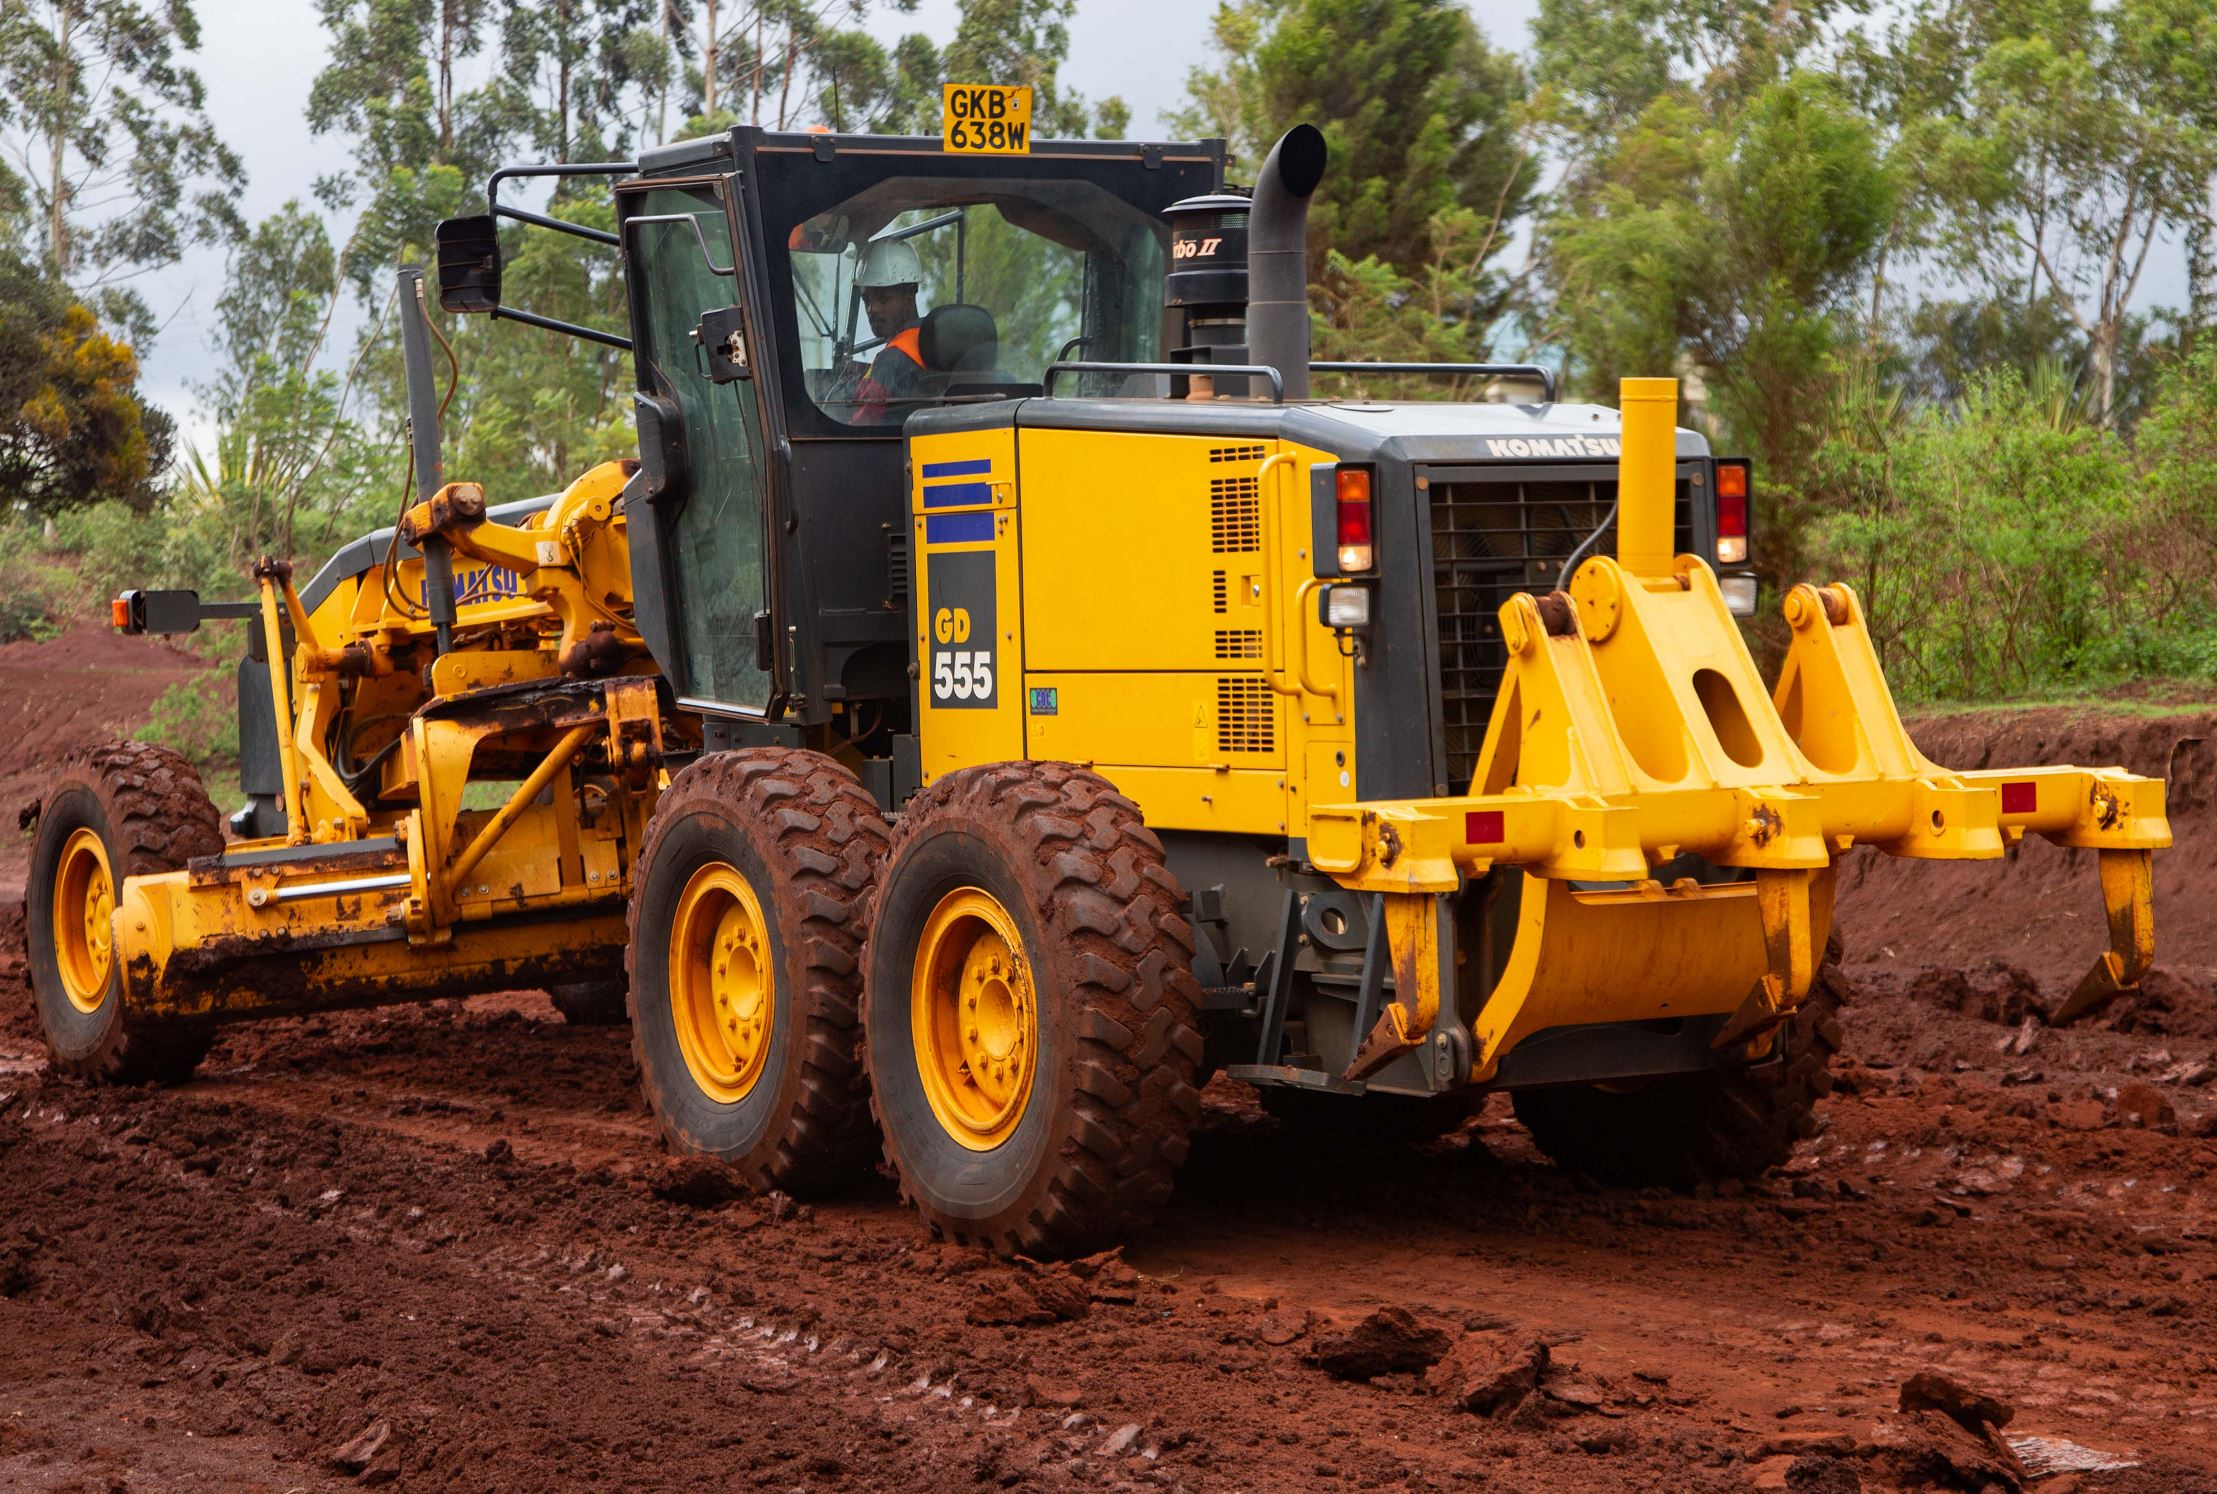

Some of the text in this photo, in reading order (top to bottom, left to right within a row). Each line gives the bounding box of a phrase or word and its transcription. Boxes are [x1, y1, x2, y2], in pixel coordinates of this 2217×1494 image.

[951, 89, 1006, 119] GKB
[951, 120, 1025, 149] 638W
[1197, 238, 1222, 256] II
[1486, 434, 1622, 457] KOMATSU
[935, 608, 971, 644] GD
[934, 651, 993, 700] 555
